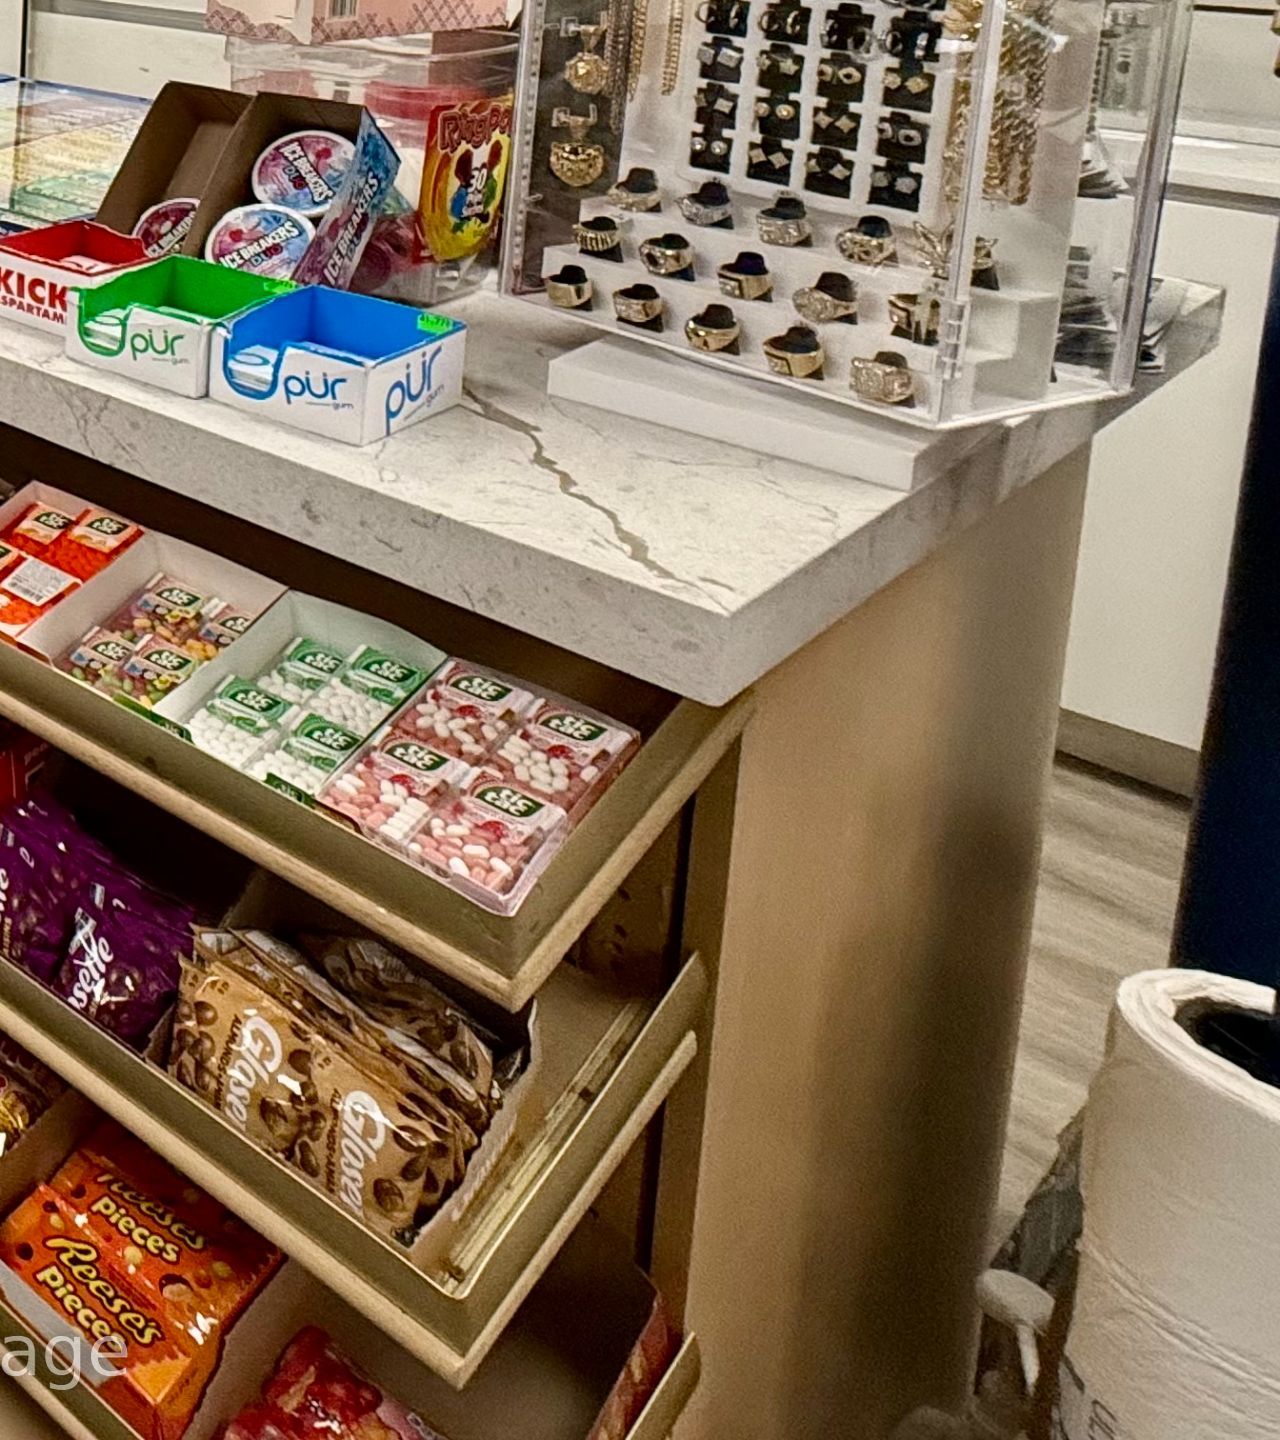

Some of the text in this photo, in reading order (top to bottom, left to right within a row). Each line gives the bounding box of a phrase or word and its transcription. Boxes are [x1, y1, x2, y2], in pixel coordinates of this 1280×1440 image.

[279, 140, 336, 204] ICE BREAKERS
[467, 168, 486, 192] 30
[323, 172, 380, 286] ICE BREAKERS
[239, 221, 301, 259] BREAKERS
[131, 328, 185, 362] pür
[284, 371, 346, 405] pür
[47, 510, 70, 522] tic
[99, 516, 123, 527] tic
[38, 517, 64, 530] tac
[92, 522, 116, 536] tac
[167, 593, 194, 607] tac
[175, 588, 199, 600] tic
[109, 641, 131, 652] tic
[99, 648, 122, 660] tac
[169, 652, 189, 663] tic
[316, 653, 340, 665] tic
[160, 657, 186, 671] tac
[306, 660, 332, 673] tac
[389, 664, 415, 676] tic
[382, 670, 407, 684] tac
[472, 678, 501, 690] tic
[452, 683, 490, 699] tac
[241, 698, 266, 713] tac
[249, 693, 274, 704] tic
[571, 716, 599, 730] tic
[321, 729, 347, 741] tic
[554, 723, 589, 740] tac
[312, 735, 340, 749] tac
[406, 745, 437, 760] tic
[392, 754, 429, 771] tac
[500, 786, 532, 802] tic
[486, 795, 526, 815] tac
